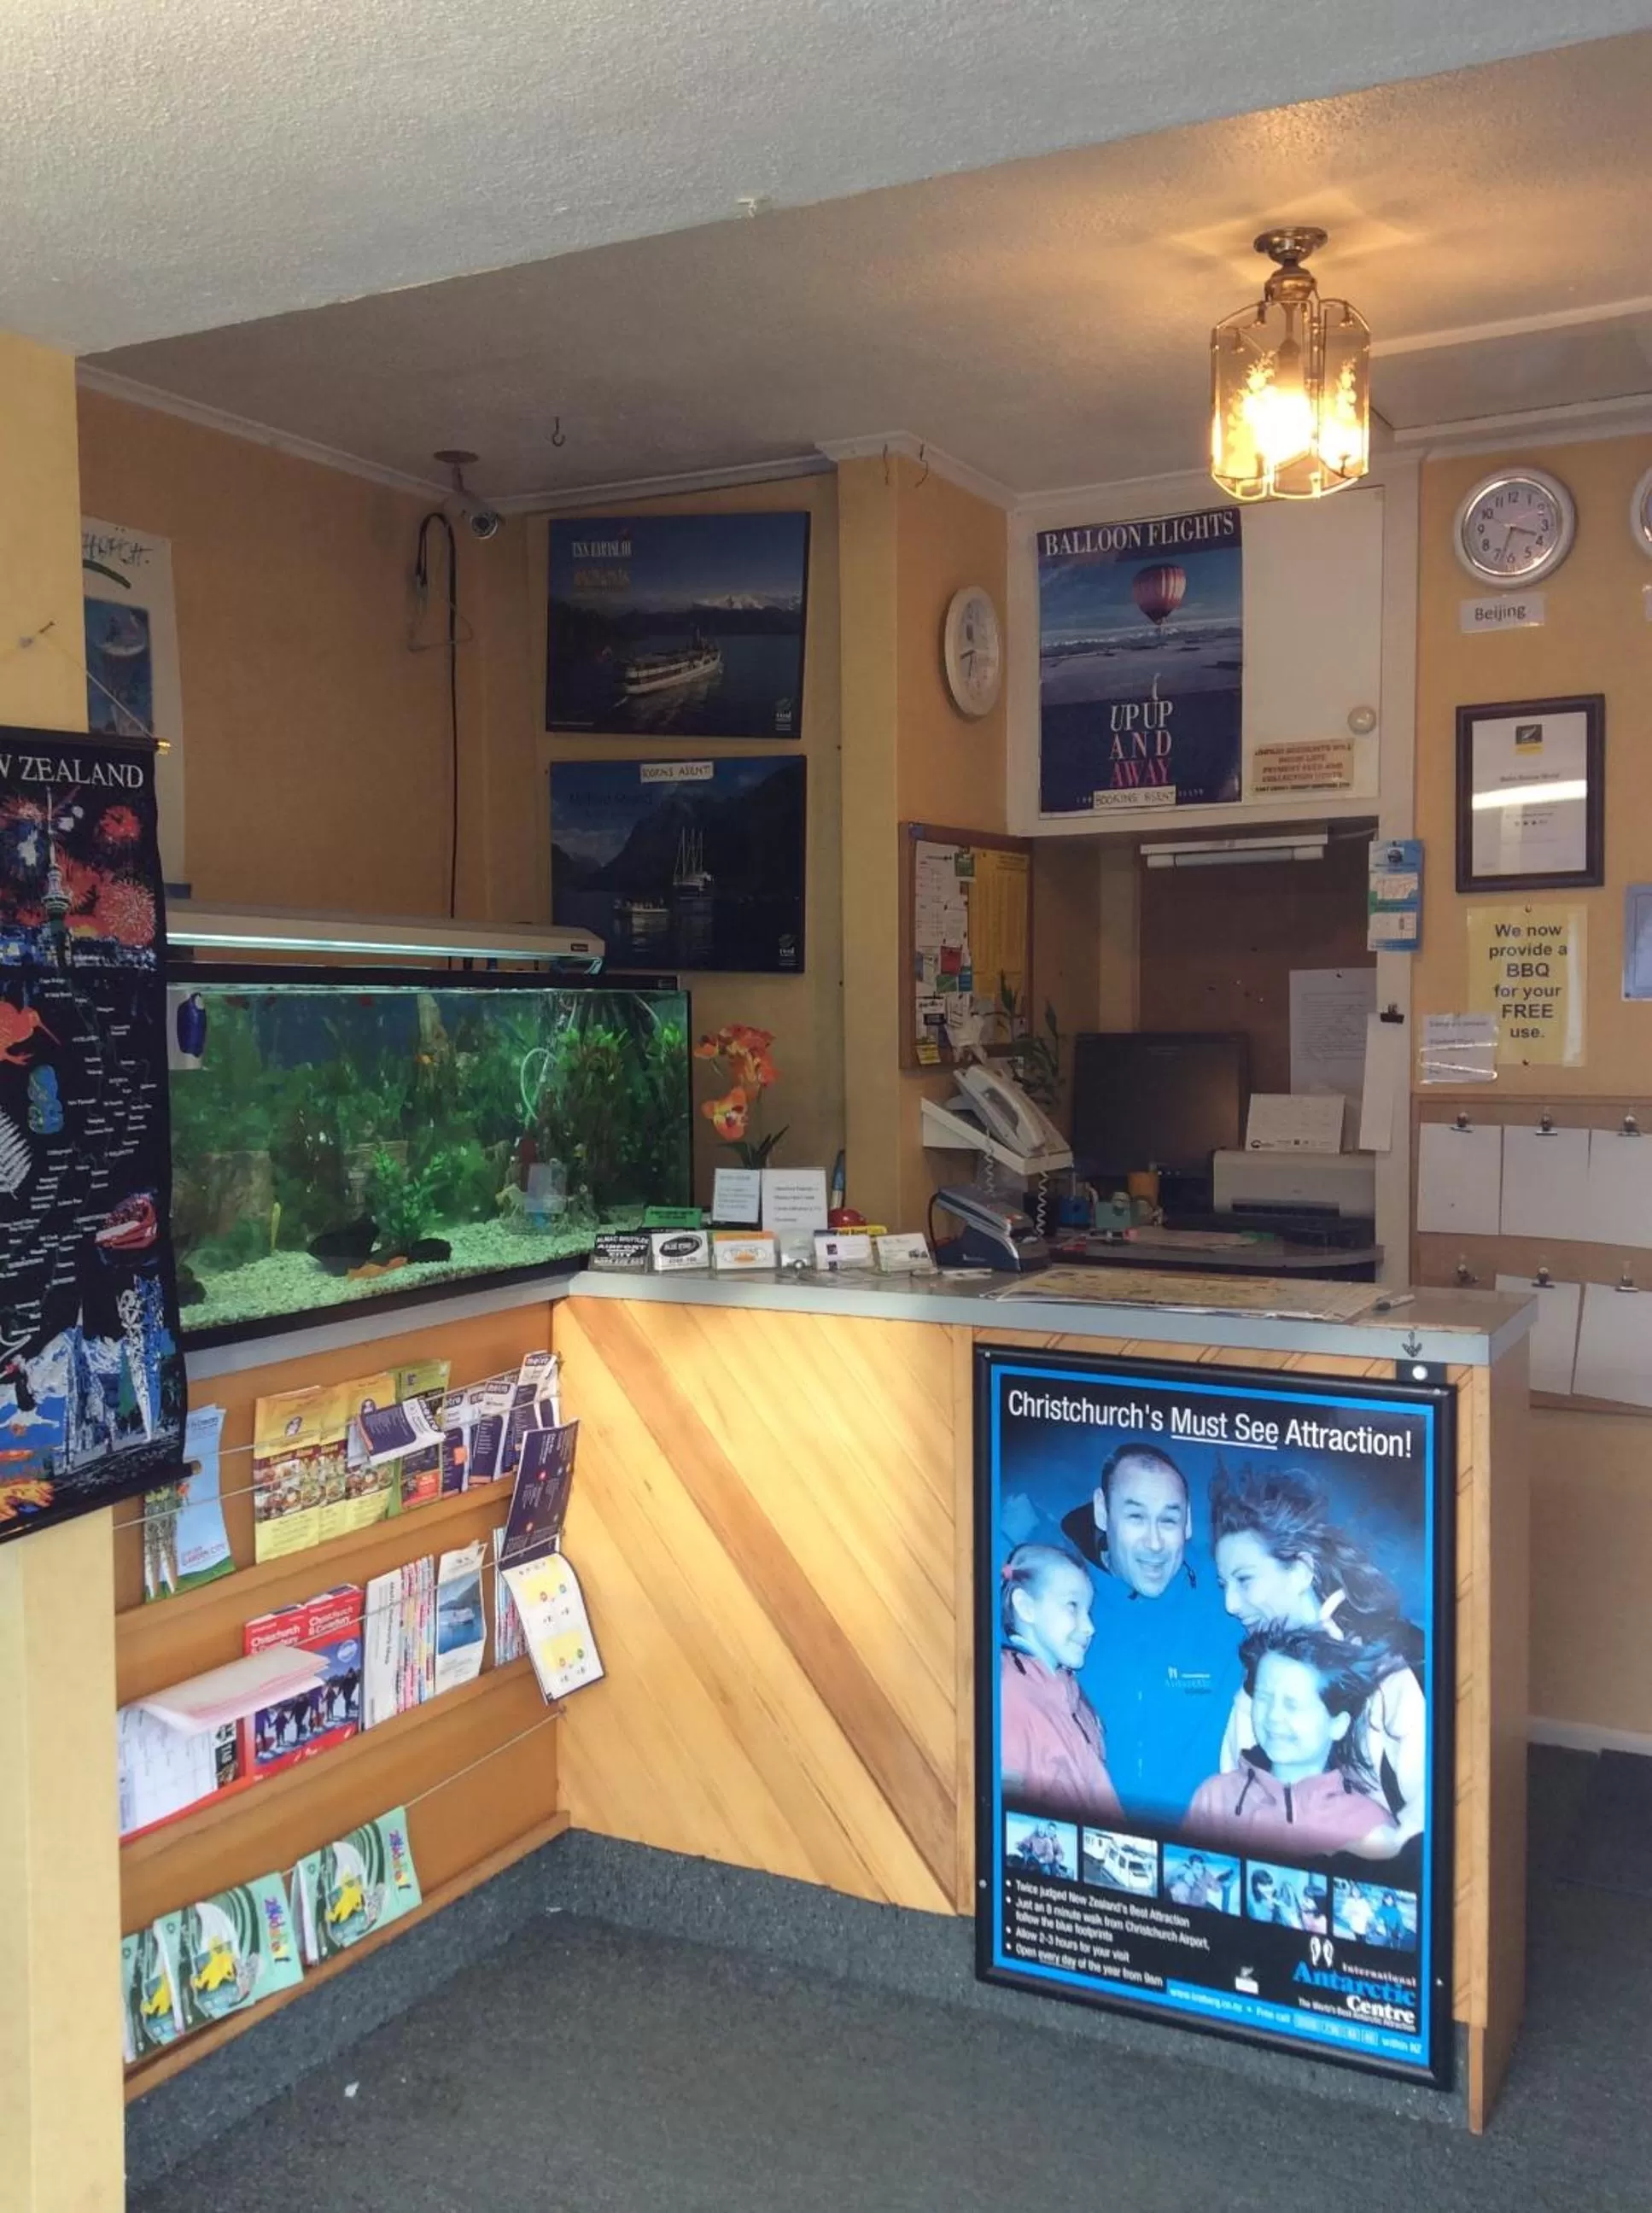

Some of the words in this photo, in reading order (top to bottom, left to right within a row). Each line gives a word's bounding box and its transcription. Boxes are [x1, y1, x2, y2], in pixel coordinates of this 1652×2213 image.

[1509, 491, 1519, 504] 12
[1045, 523, 1142, 557] BALLOON
[1147, 511, 1235, 547] FLIGHTS
[1474, 604, 1526, 622] Beijing
[1109, 731, 1172, 759] AND
[19, 756, 143, 789] ZEALAND
[1112, 759, 1172, 786] AWAY
[1495, 924, 1521, 937] We
[1526, 925, 1562, 937] now
[1489, 943, 1552, 960] provide
[1557, 945, 1567, 956] a
[1506, 962, 1550, 978] BBQ
[1493, 985, 1518, 998] for
[1522, 987, 1562, 1001] your
[1502, 1003, 1554, 1019] FREE
[1509, 1026, 1545, 1038] use.
[1008, 1388, 1164, 1432] Christchurch's
[1170, 1406, 1228, 1438] Must
[1235, 1411, 1279, 1444] See
[1285, 1418, 1413, 1458] Attraction!
[1040, 1884, 1067, 1901] judged
[1068, 1891, 1087, 1906] New
[1130, 1902, 1148, 1919] Best
[1149, 1906, 1190, 1929] Attraction
[1041, 1915, 1054, 1929] the
[1125, 1919, 1178, 1943] Christchurch
[1055, 1935, 1078, 1951] hours
[1293, 1960, 1416, 2006] Antarctic
[1342, 1961, 1416, 1988] International
[1346, 1994, 1416, 2025] Centre
